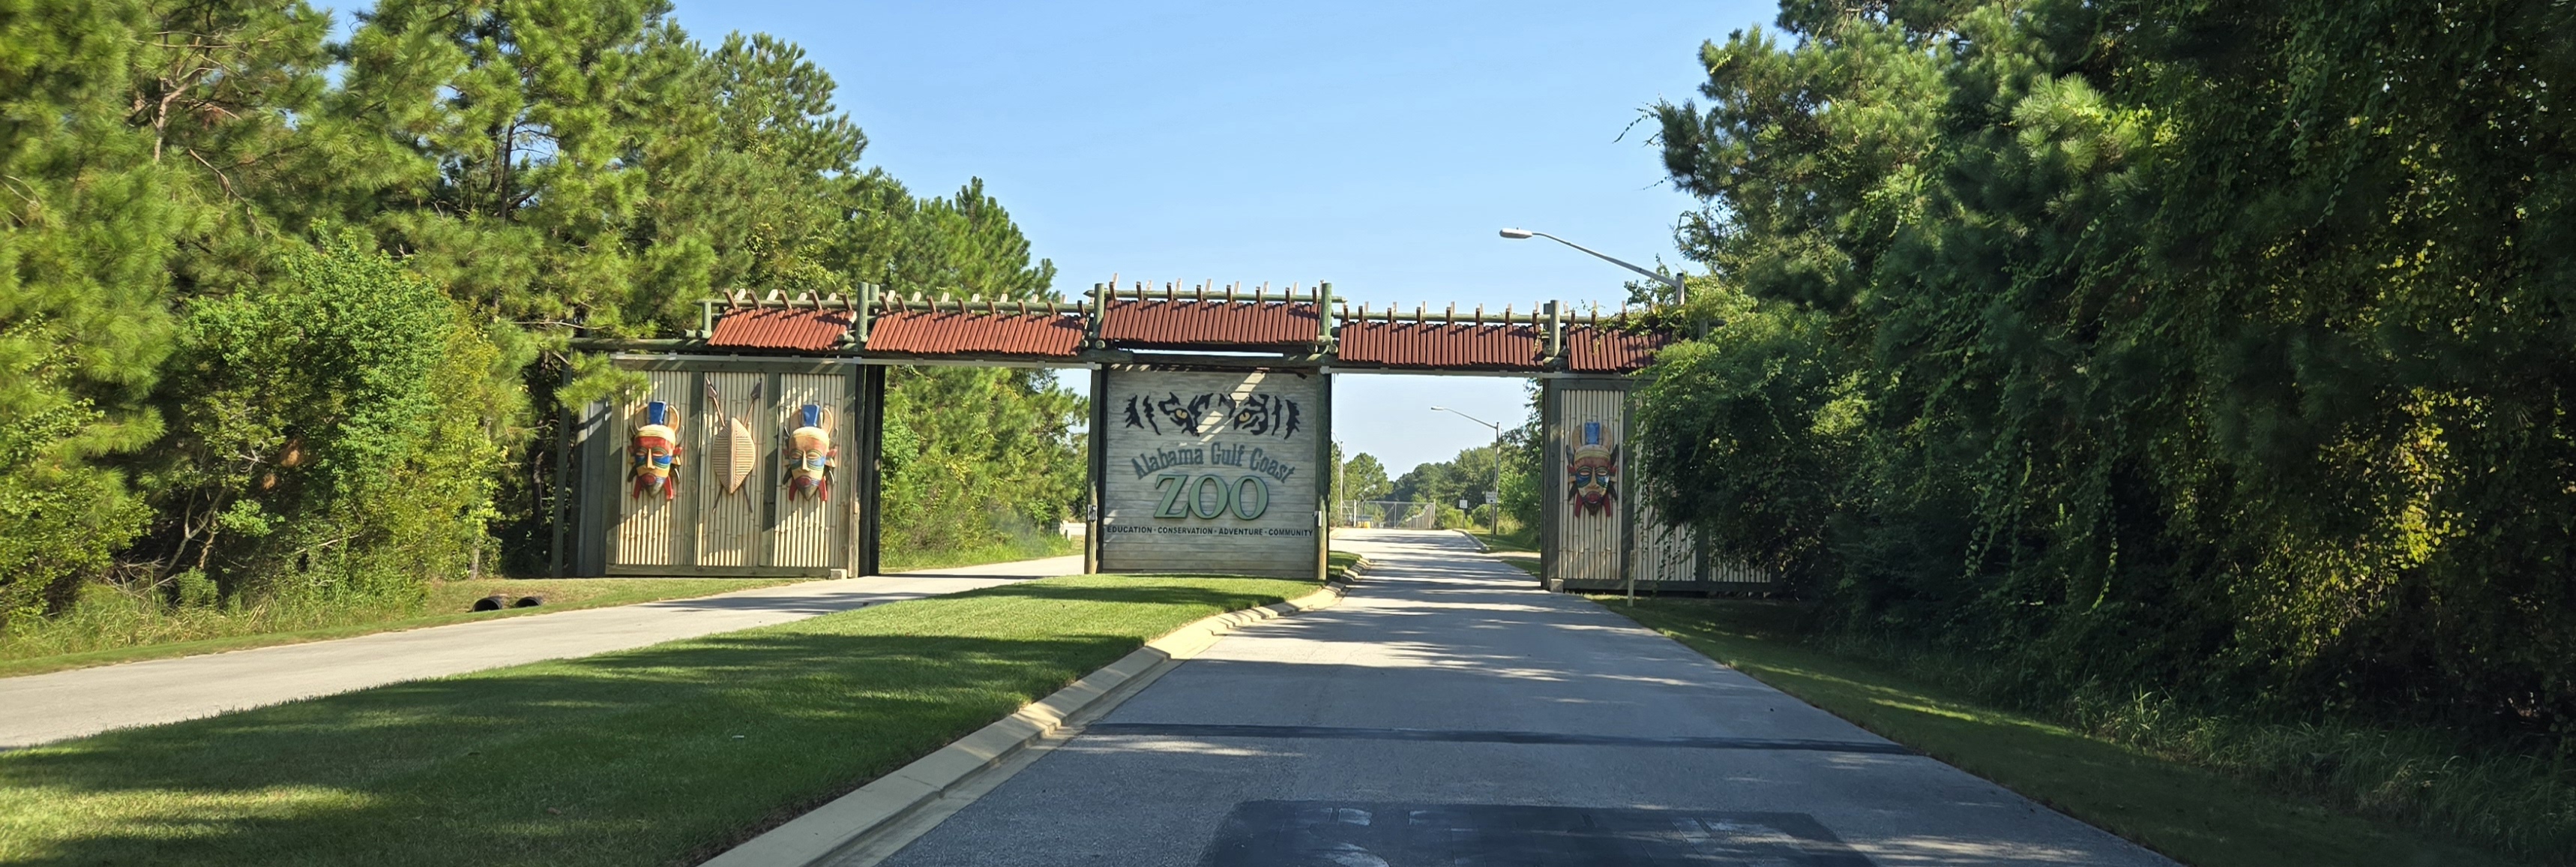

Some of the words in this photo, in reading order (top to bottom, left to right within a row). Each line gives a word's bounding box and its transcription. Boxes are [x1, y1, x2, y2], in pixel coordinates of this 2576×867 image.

[1131, 448, 1204, 480] Alabama
[1211, 442, 1245, 466] Gulf
[1250, 447, 1295, 484] Coast
[1153, 474, 1269, 520] ZOO
[1158, 526, 1213, 535] CONSERVATION
[1269, 529, 1313, 537] COMMUNITY
